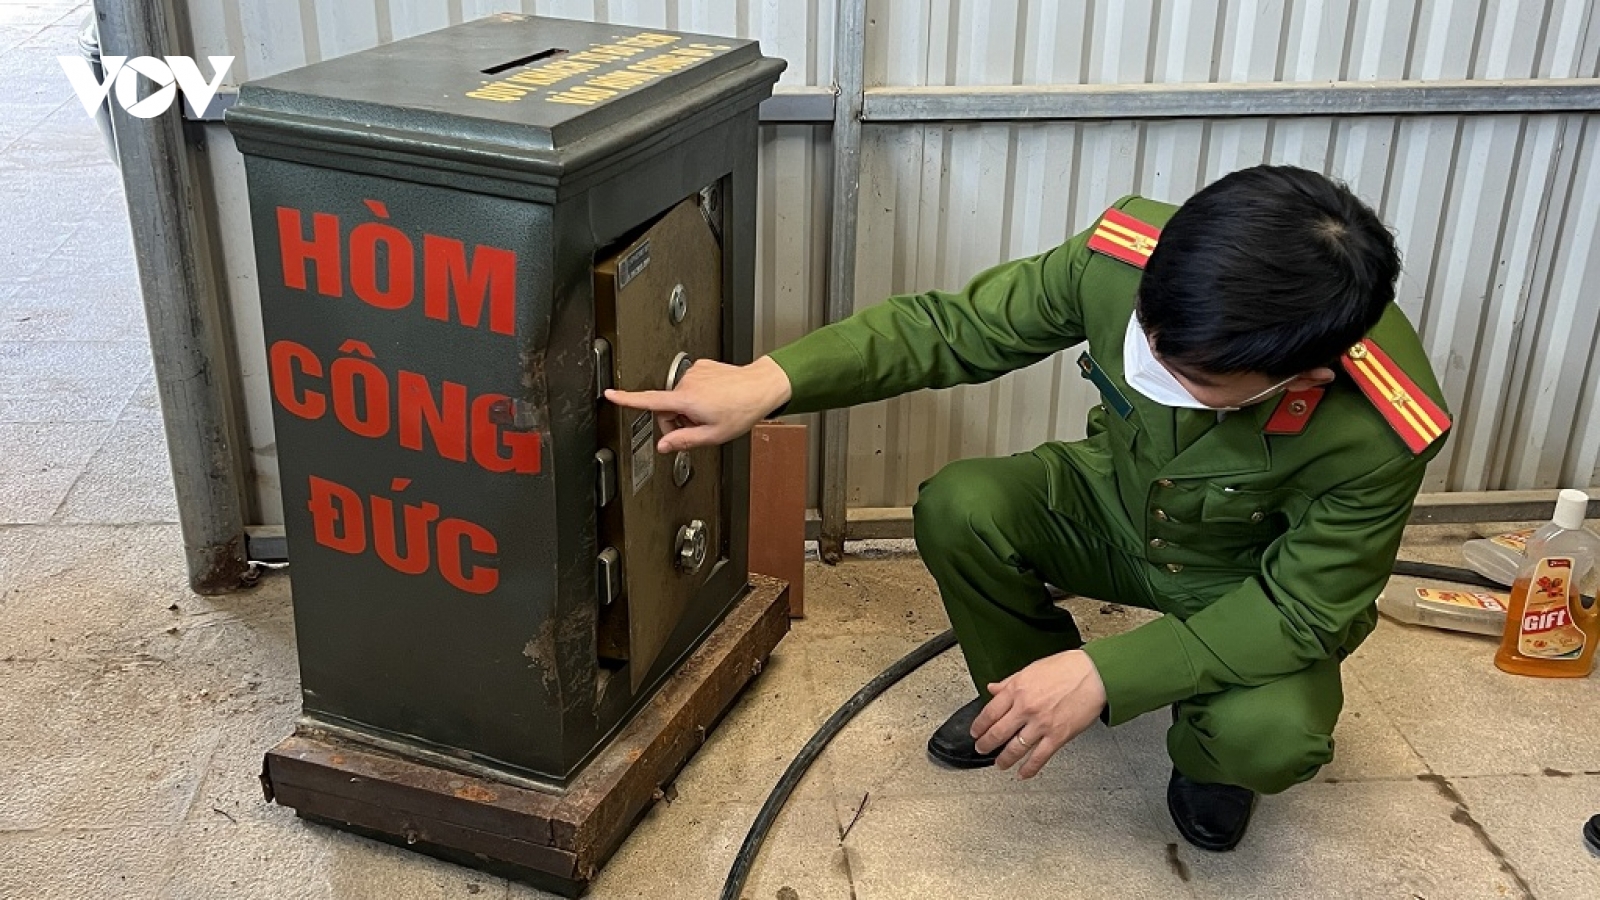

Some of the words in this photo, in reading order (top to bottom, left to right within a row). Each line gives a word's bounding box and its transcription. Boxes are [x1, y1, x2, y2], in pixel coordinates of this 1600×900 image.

[276, 199, 517, 336] HÒM
[269, 338, 542, 475] CÔNG
[308, 475, 499, 595] ĐỨC
